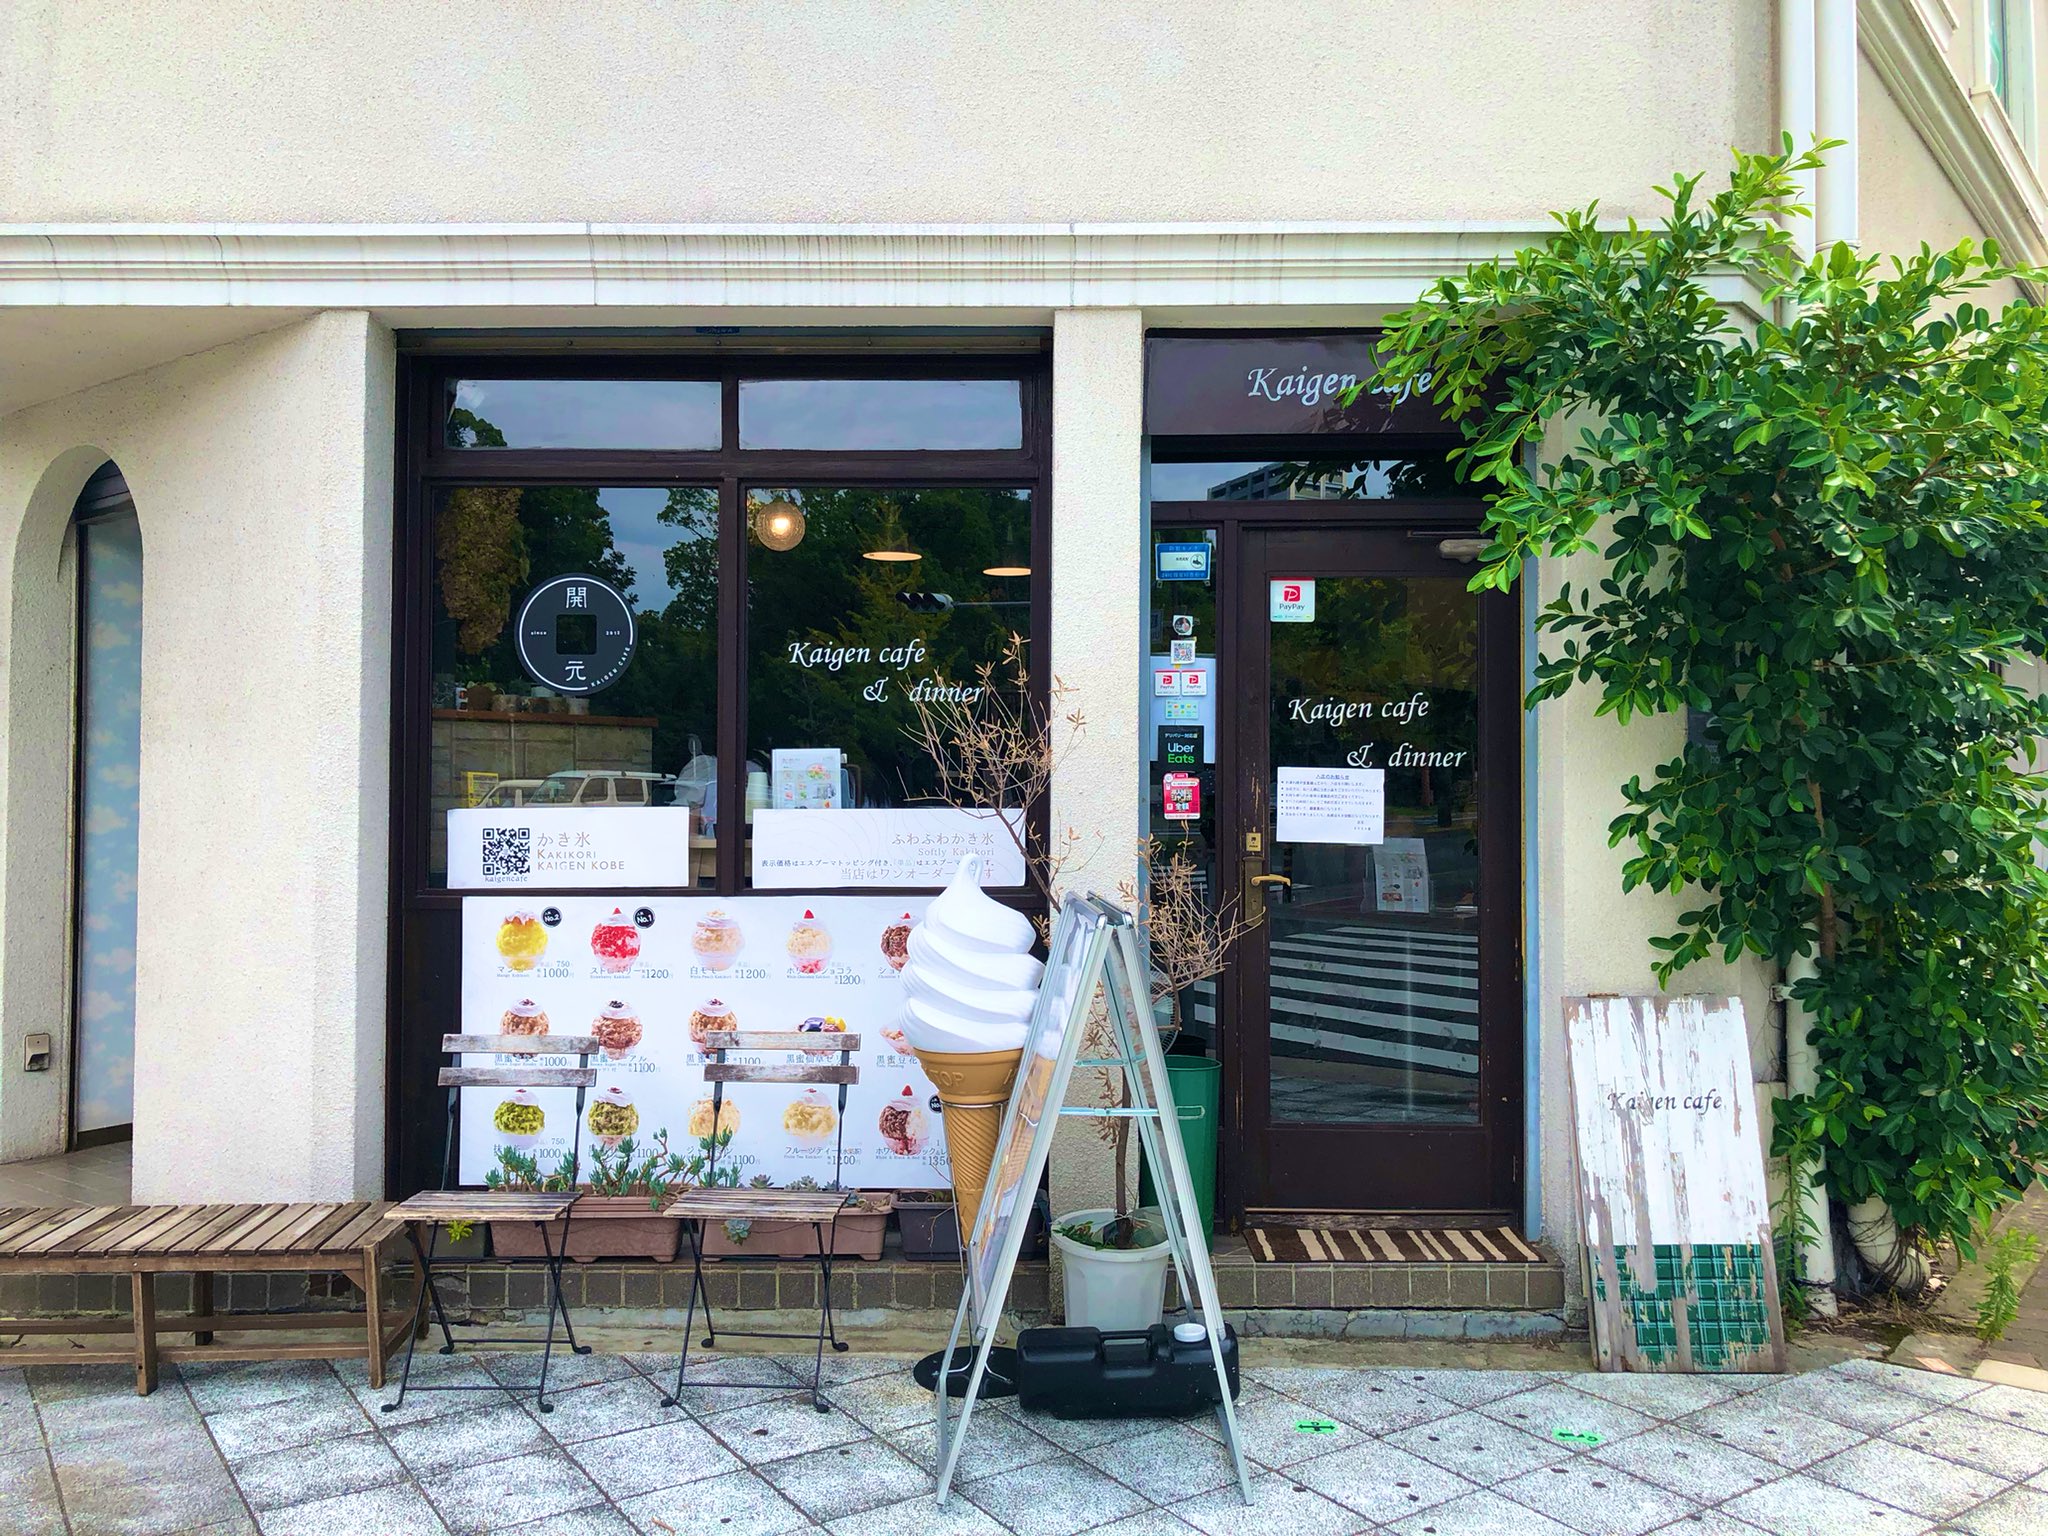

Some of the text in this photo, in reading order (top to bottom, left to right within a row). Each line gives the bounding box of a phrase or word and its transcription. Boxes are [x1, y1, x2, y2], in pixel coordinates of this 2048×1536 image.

[1247, 365, 1357, 406] Kaigen
[566, 586, 587, 608] 開
[1279, 603, 1306, 611] PayPay
[788, 638, 926, 671] Kaigen cafe
[565, 660, 586, 682] 元
[590, 668, 618, 687] KAIGEN
[862, 676, 986, 703] & dinner
[1288, 692, 1430, 727] Kaigen cafe
[1168, 742, 1194, 752] Uber
[1346, 742, 1467, 768] & dinner
[1168, 754, 1195, 764] Eats
[538, 831, 591, 848] かき氷
[892, 832, 994, 846] ふわふわかき氷
[918, 848, 994, 858] Softly Kakikori
[538, 860, 625, 871] KAIGEN KOBE
[841, 868, 994, 880] 当店はワンオーダーす
[484, 874, 528, 883] kaigencafe
[1606, 1089, 1722, 1115] Kaien cafe
